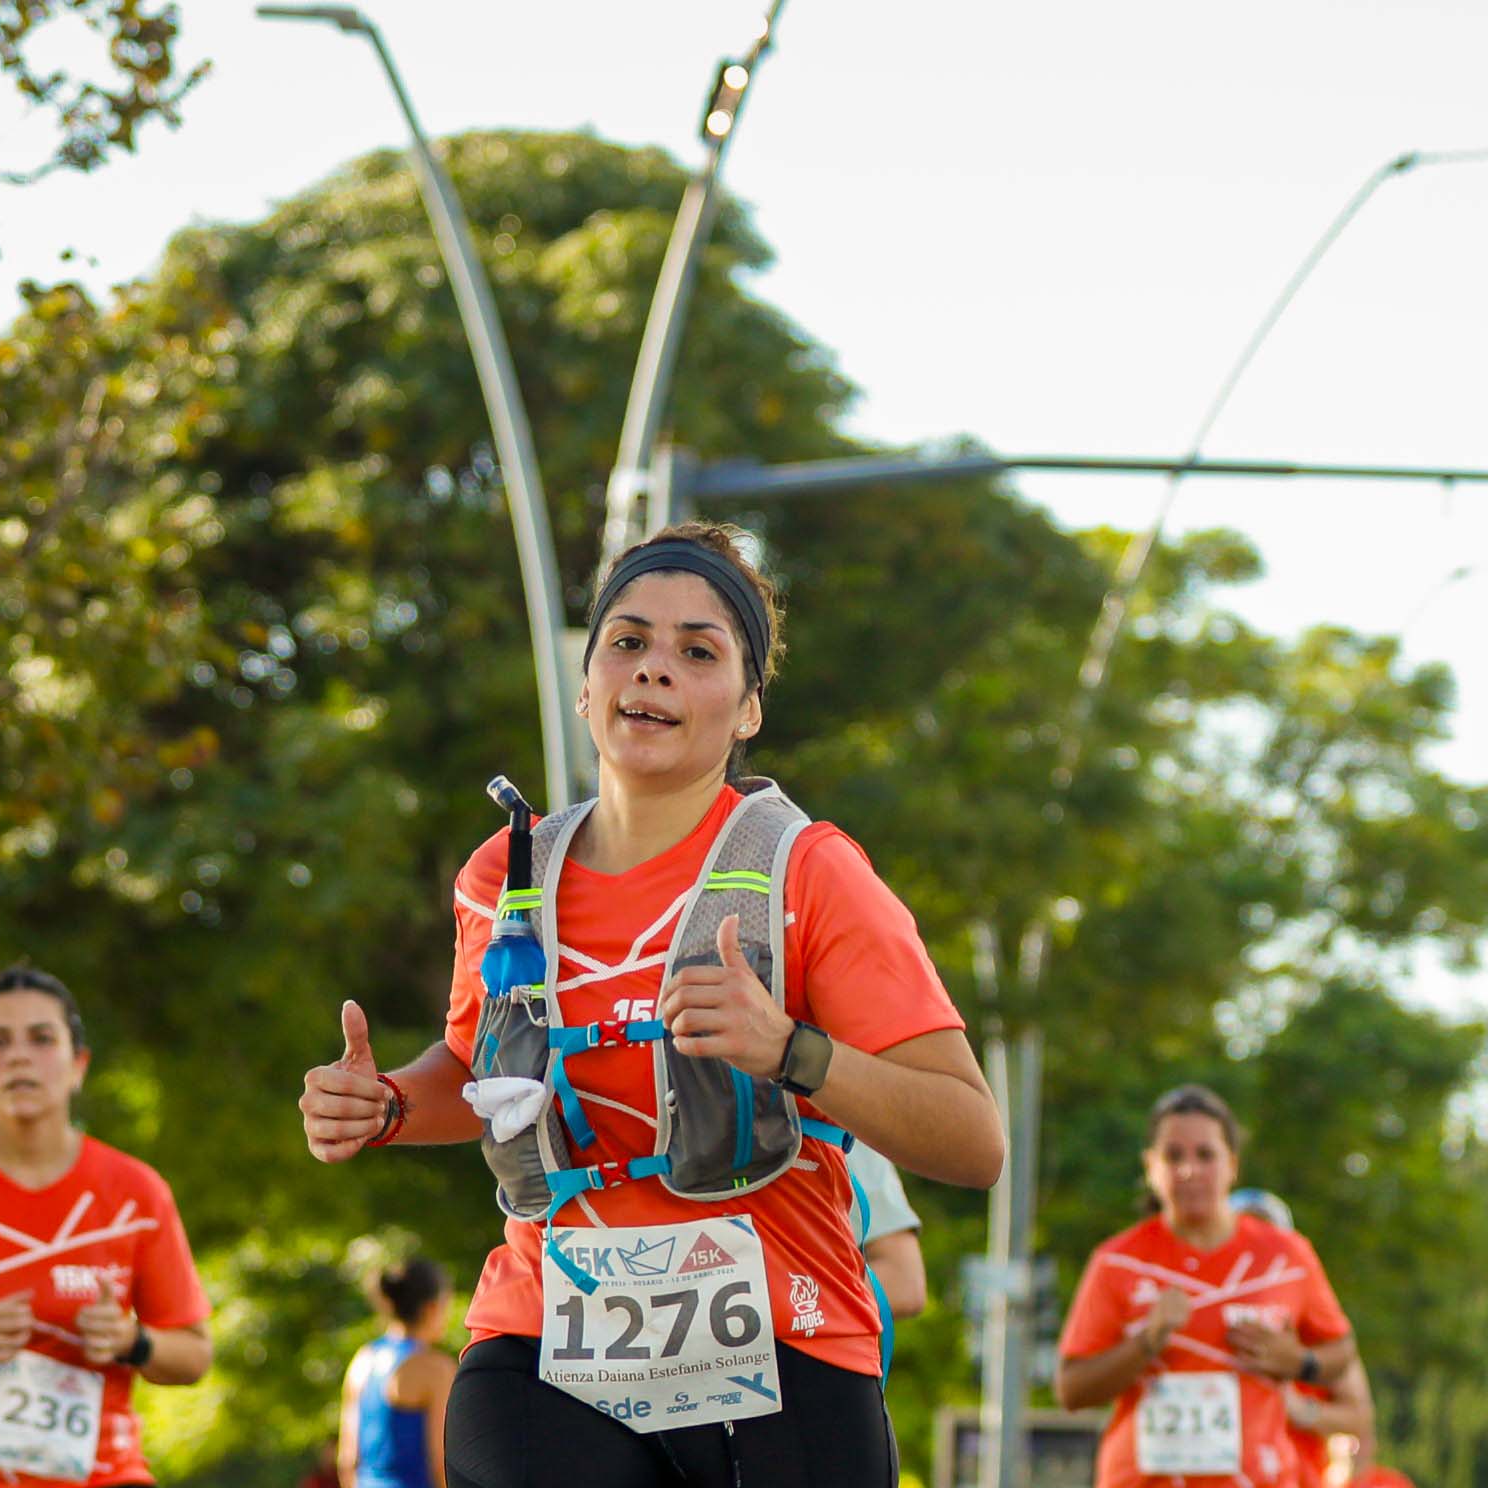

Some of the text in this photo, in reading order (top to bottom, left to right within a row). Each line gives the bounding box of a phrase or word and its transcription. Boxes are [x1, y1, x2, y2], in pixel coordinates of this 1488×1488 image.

[690, 1249, 722, 1267] 15K
[552, 1281, 762, 1361] 1276
[543, 1351, 771, 1384] Atienza Daiana Estefania Solange
